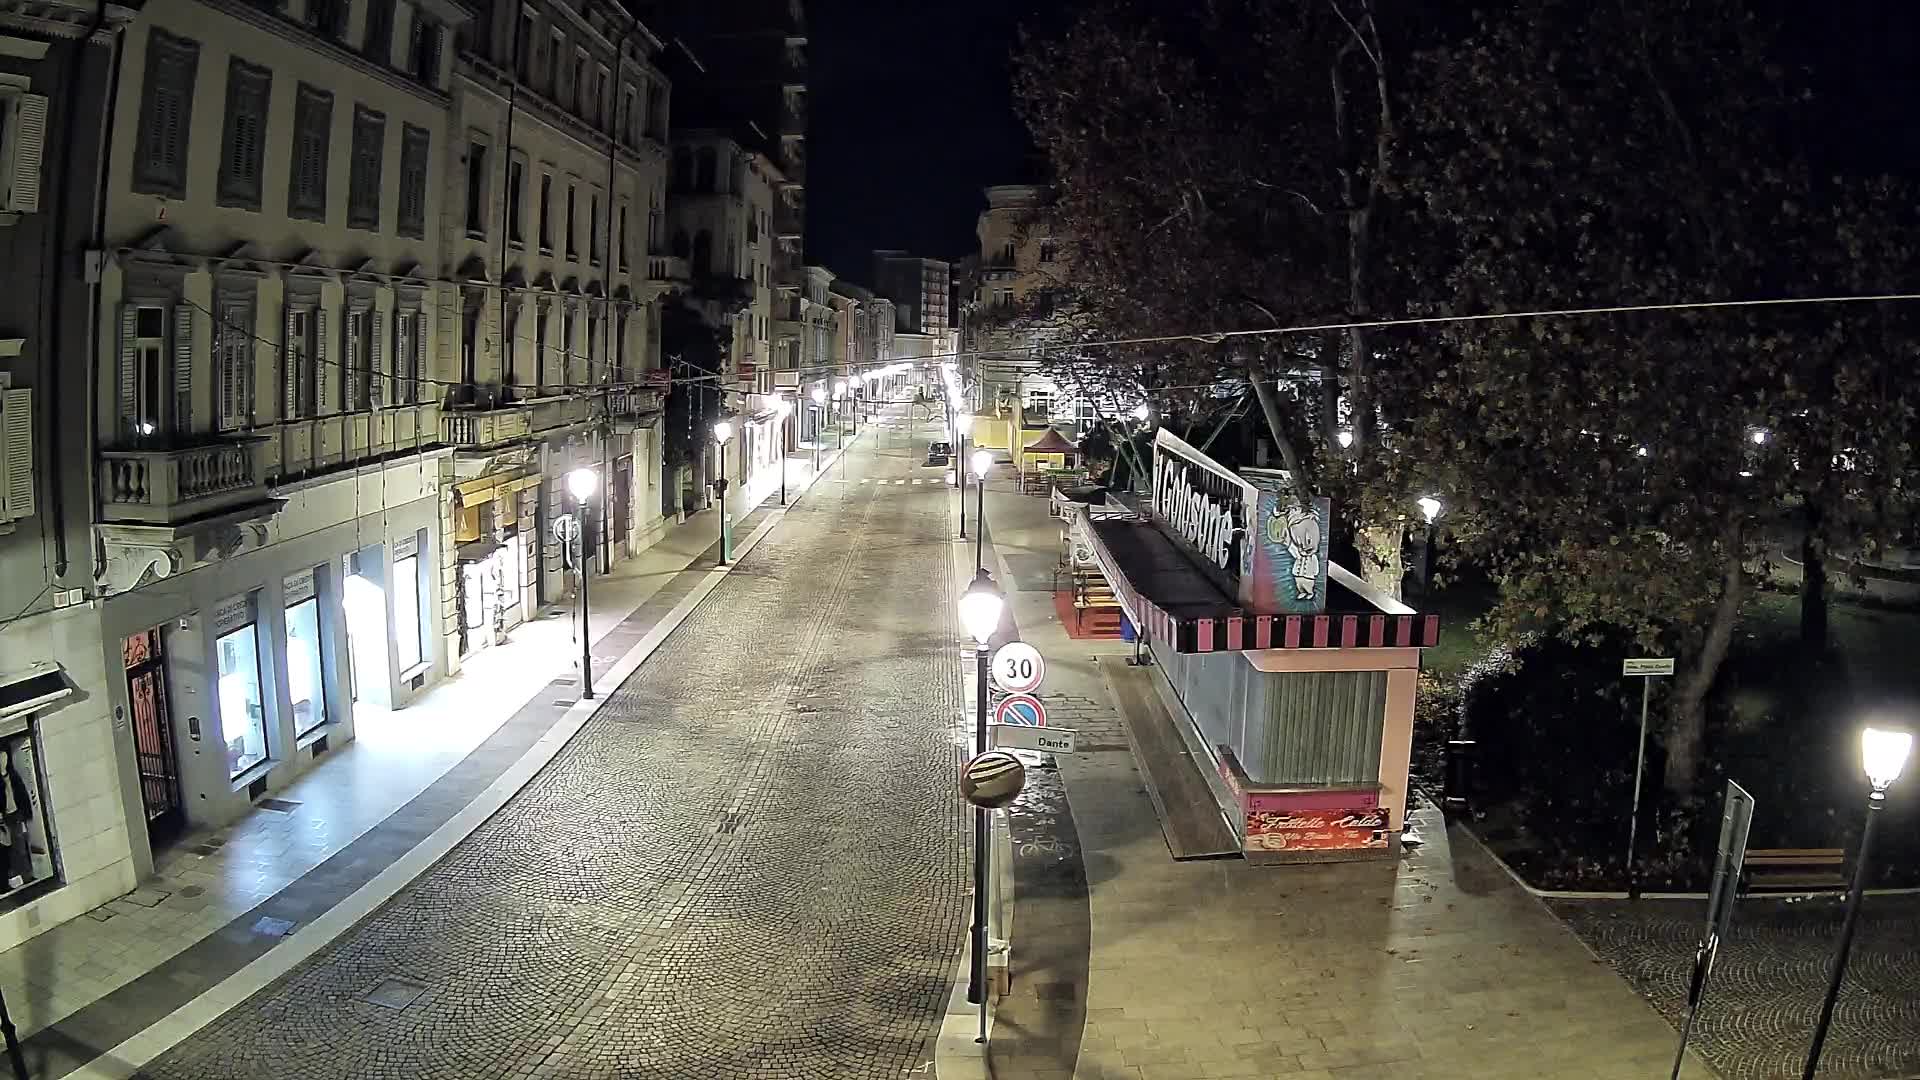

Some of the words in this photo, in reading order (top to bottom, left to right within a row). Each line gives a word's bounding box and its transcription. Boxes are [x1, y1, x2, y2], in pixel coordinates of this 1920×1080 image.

[1162, 458, 1233, 569] Golosone
[1006, 658, 1032, 678] 30
[1038, 737, 1070, 749] Dante
